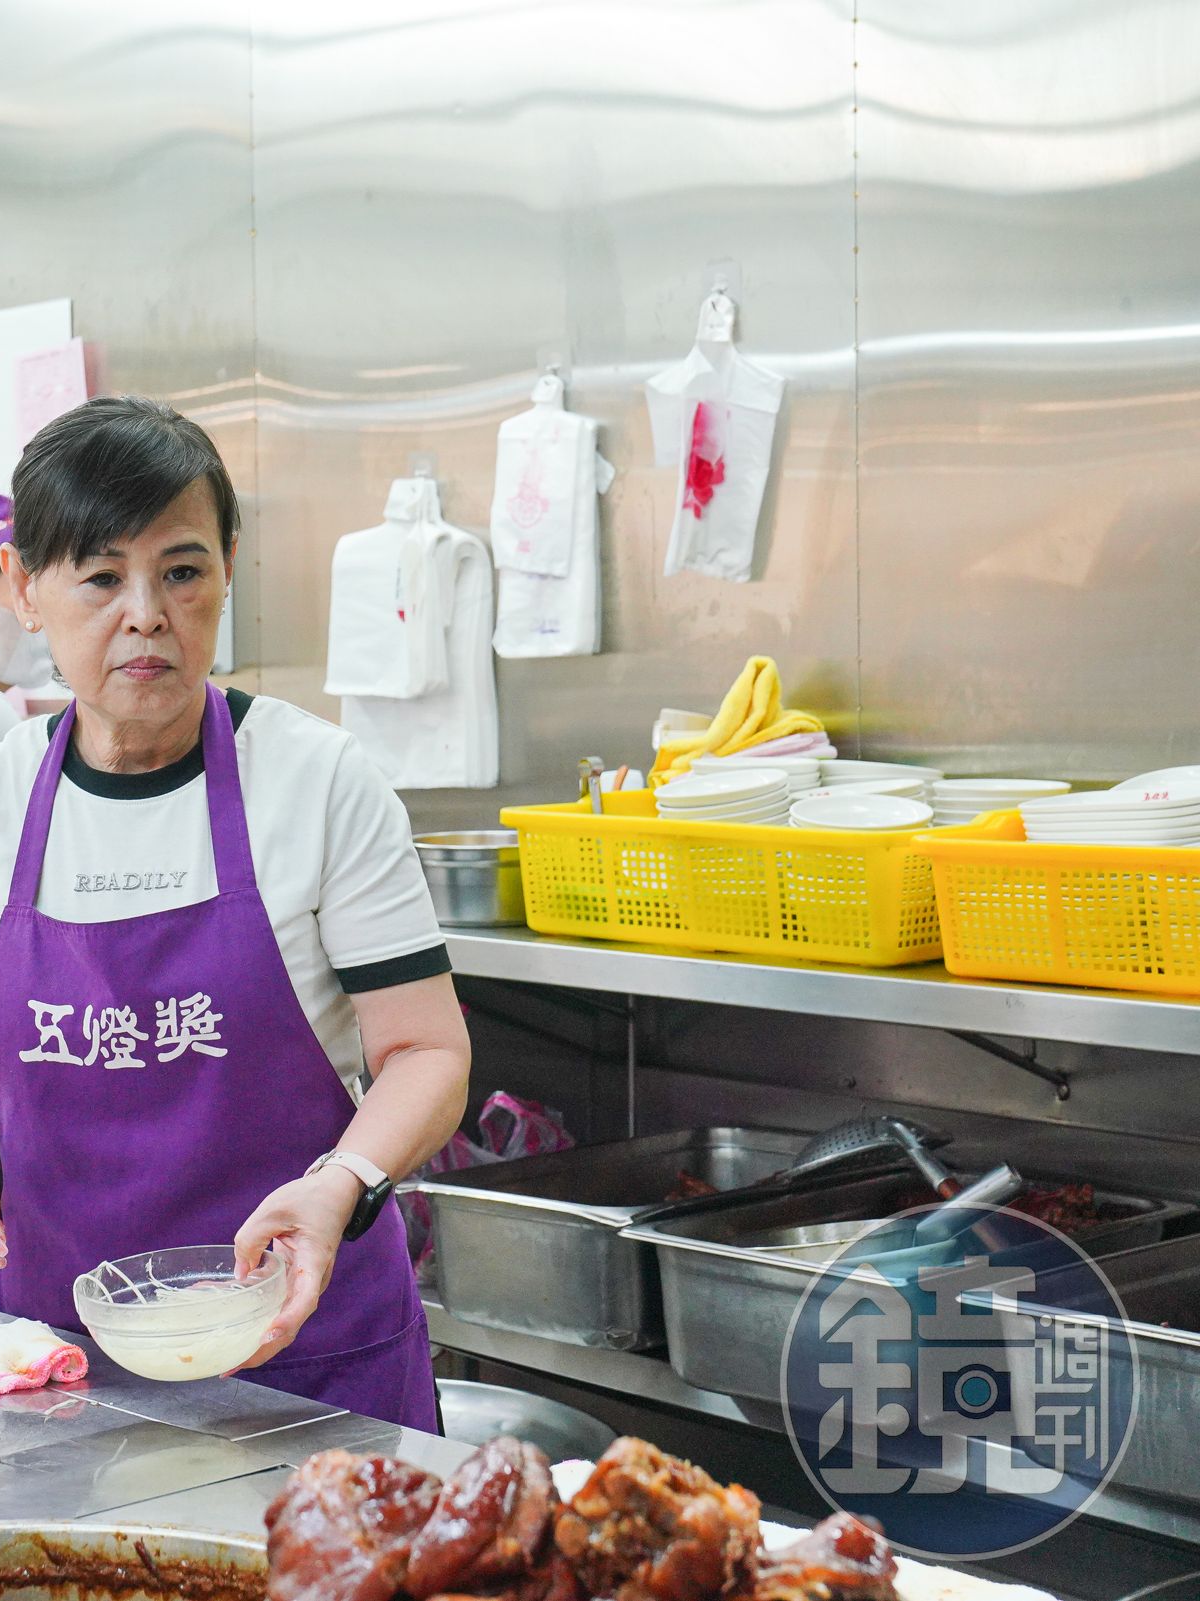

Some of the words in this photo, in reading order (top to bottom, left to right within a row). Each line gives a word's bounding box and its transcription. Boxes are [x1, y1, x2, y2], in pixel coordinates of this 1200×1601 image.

[74, 871, 187, 892] READILY
[19, 991, 228, 1069] 五燈獎
